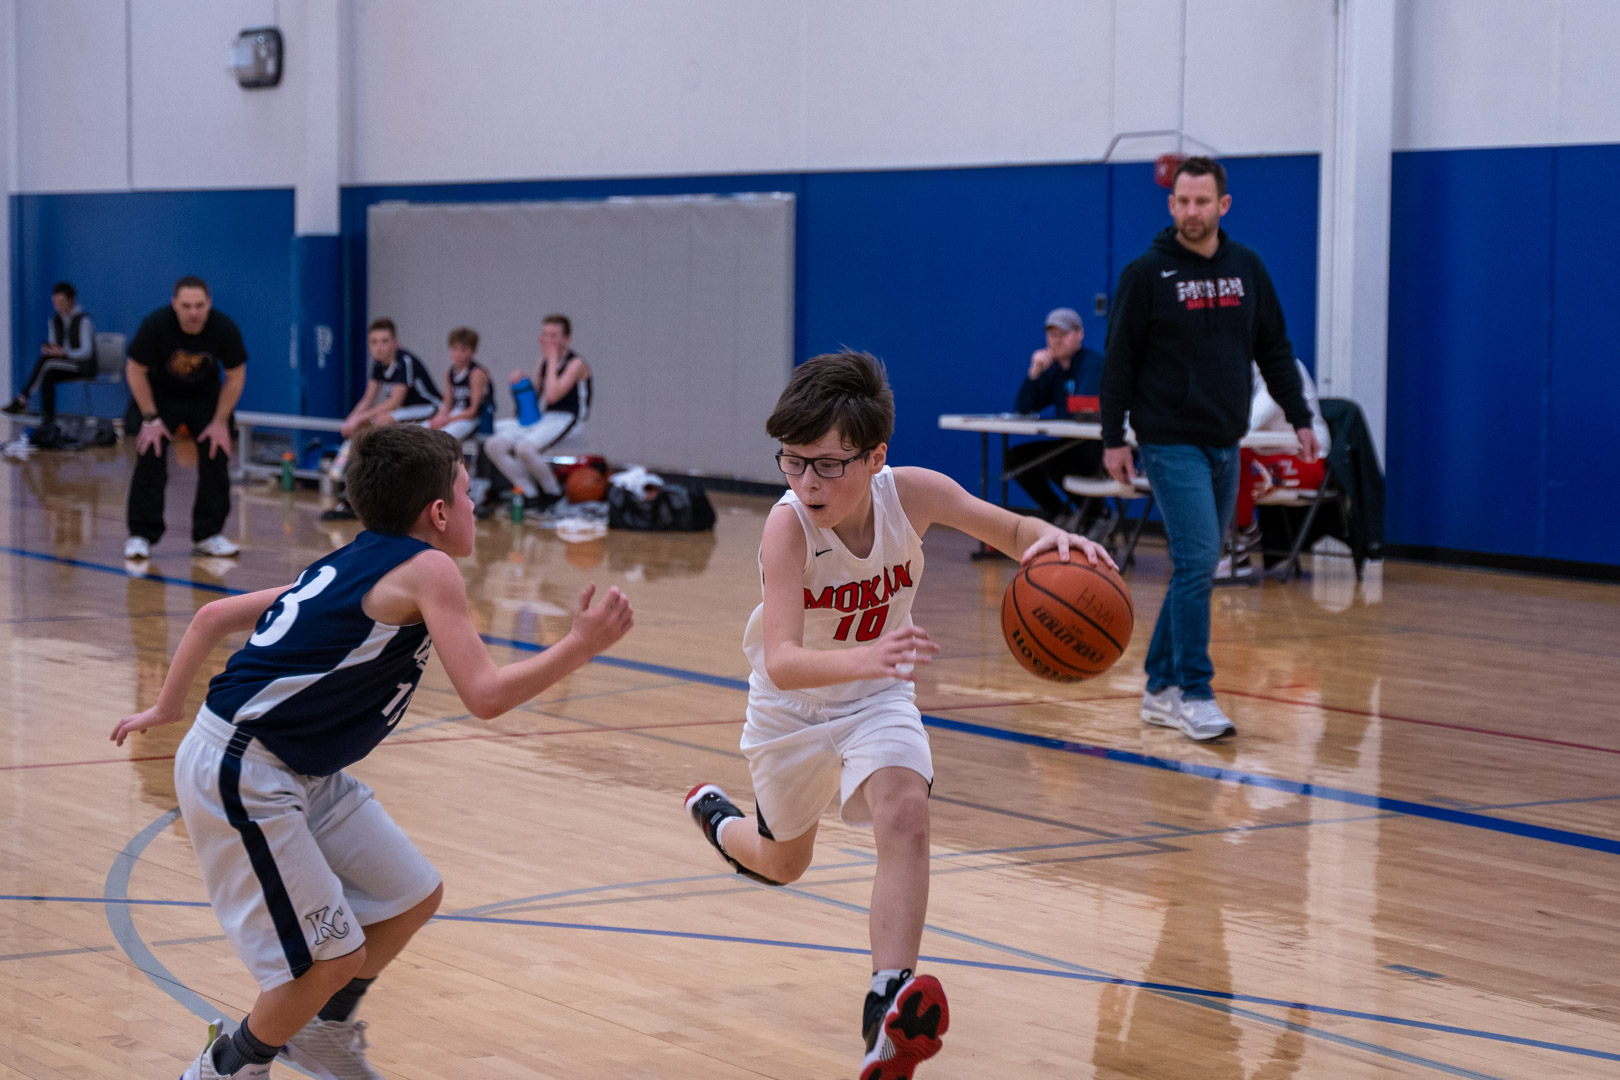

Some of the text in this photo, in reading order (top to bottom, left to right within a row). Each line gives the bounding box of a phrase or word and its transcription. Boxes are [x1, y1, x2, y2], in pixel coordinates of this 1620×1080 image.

[803, 559, 913, 613] MOKAN
[832, 603, 890, 643] 10
[304, 905, 350, 946] KC
